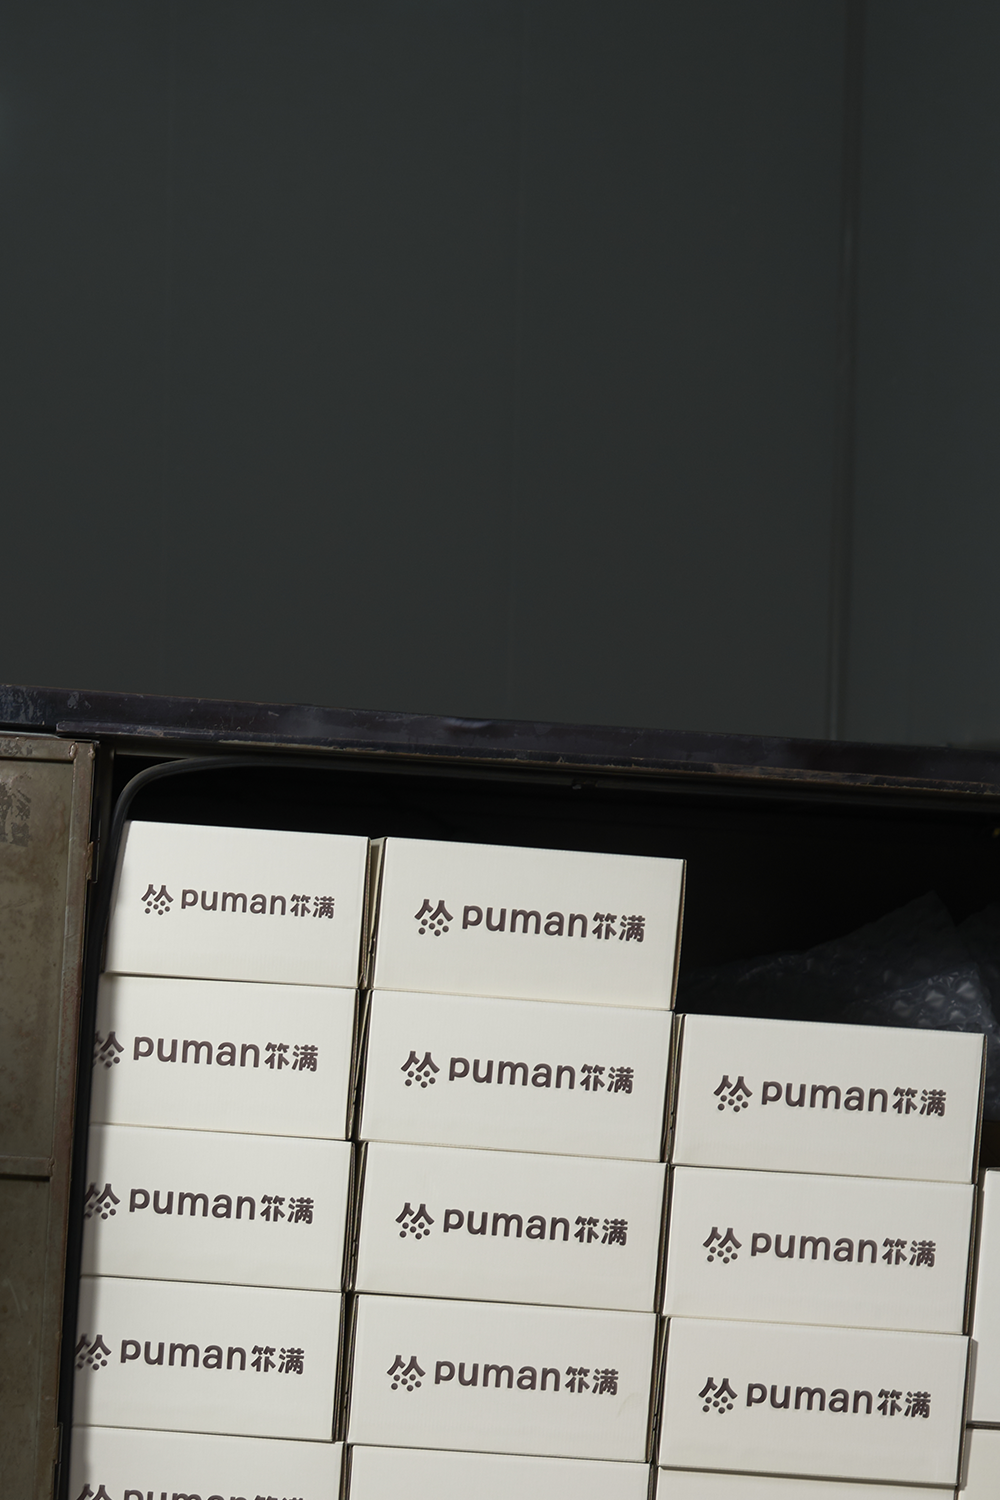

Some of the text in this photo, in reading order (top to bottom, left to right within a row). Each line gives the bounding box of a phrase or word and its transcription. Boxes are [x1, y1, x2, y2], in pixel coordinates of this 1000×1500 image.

[180, 889, 287, 916] puman
[461, 905, 588, 939] puman
[133, 1036, 260, 1068] puman
[448, 1057, 576, 1090] puman
[761, 1081, 889, 1113] puman
[128, 1188, 256, 1221] puman
[442, 1208, 570, 1242] puman
[750, 1232, 878, 1264] puman
[120, 1339, 247, 1371] puman
[434, 1360, 561, 1392] puman
[746, 1383, 873, 1415] puman
